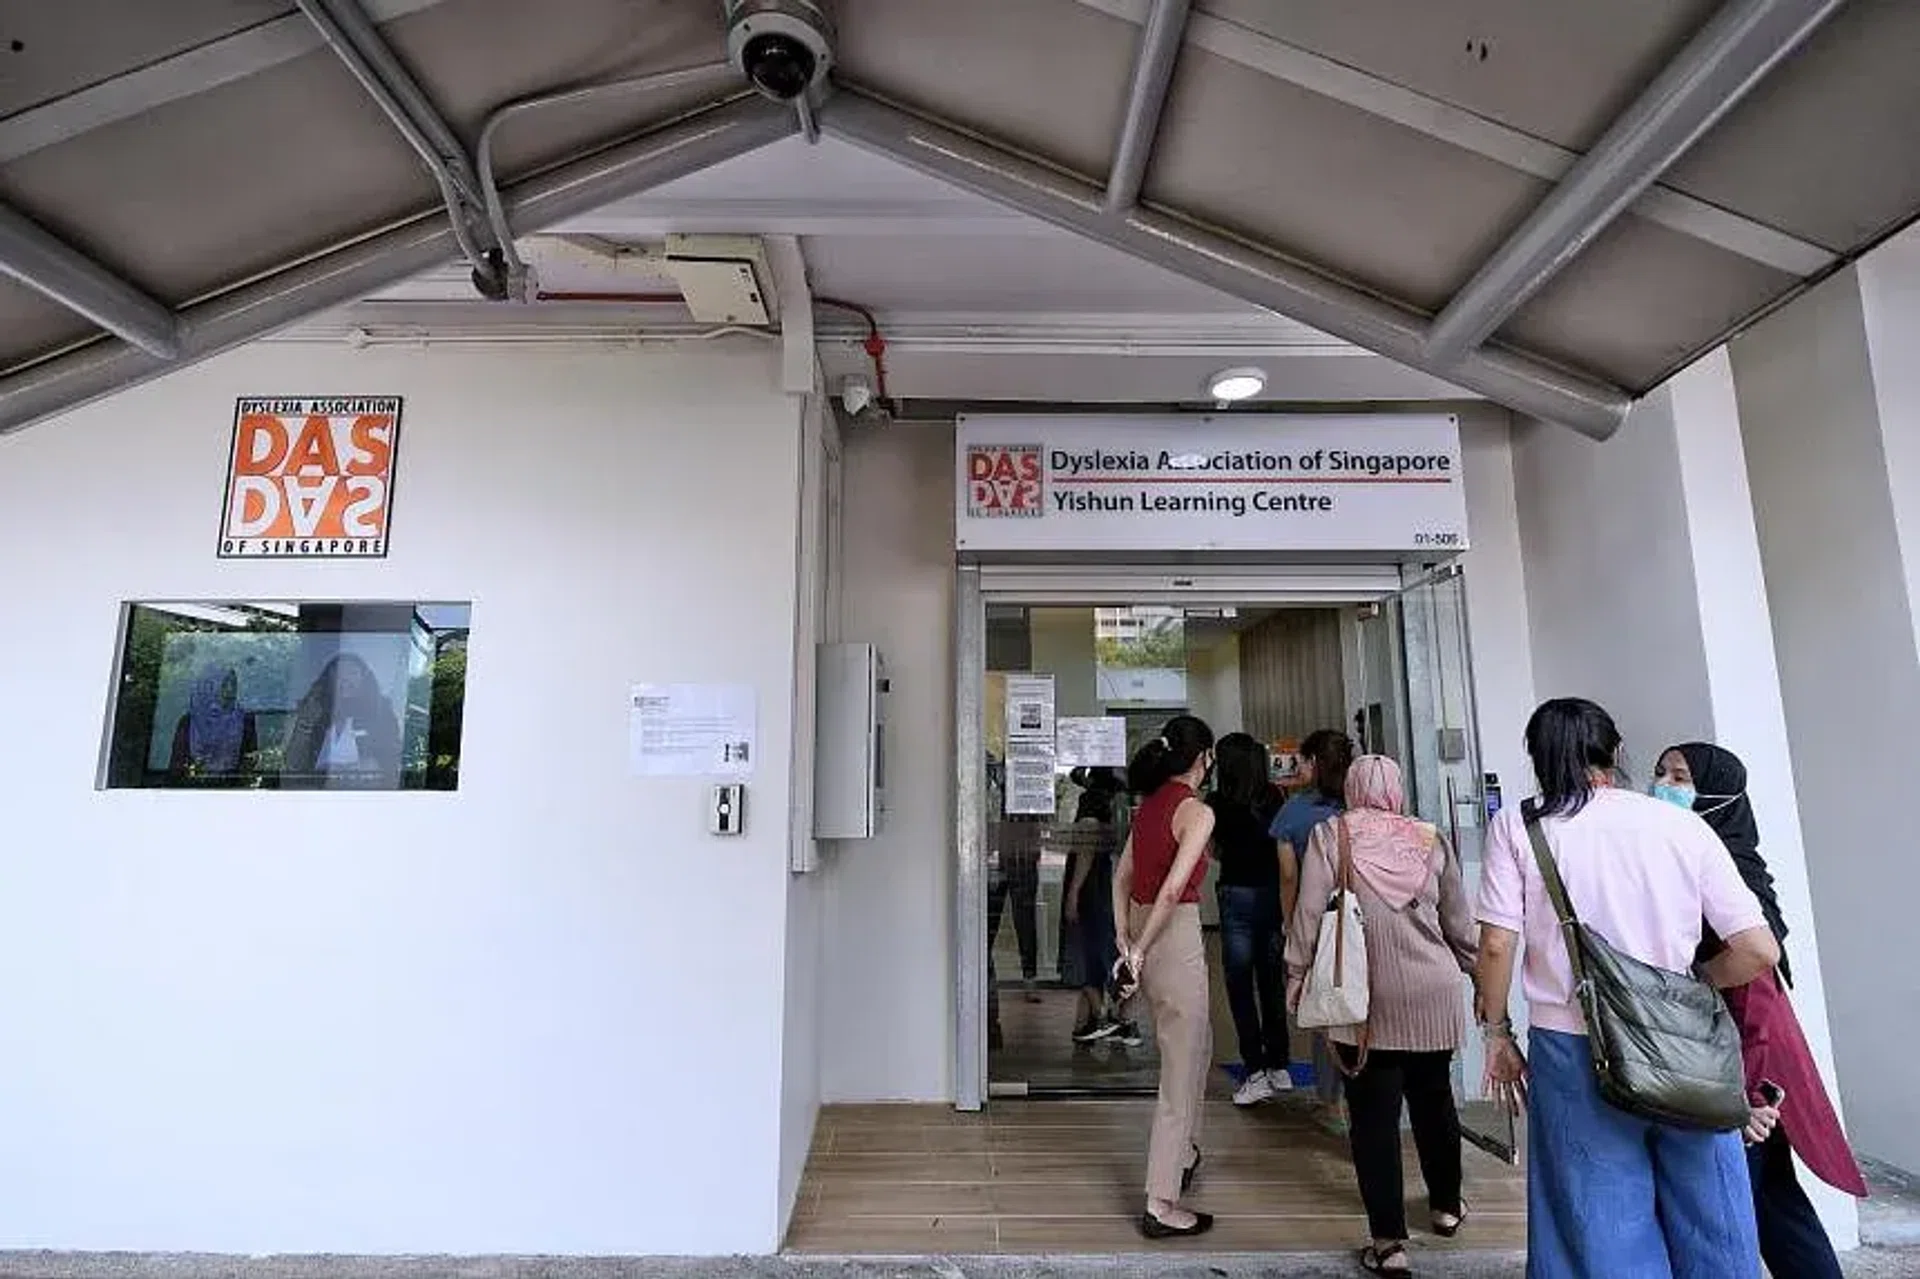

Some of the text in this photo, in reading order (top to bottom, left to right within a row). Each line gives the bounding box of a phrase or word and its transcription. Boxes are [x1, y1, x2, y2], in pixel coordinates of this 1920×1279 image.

[241, 400, 396, 413] DYSLEXIA ASSOCIATION
[235, 415, 392, 476] DAS
[969, 453, 1039, 480] DAS
[1051, 450, 1149, 475] Dyslexia
[1299, 450, 1323, 470] of
[1329, 450, 1451, 475] Singapore
[1053, 491, 1332, 517] Yishun Learning Centre
[223, 540, 382, 553] OF SINGAPORE
